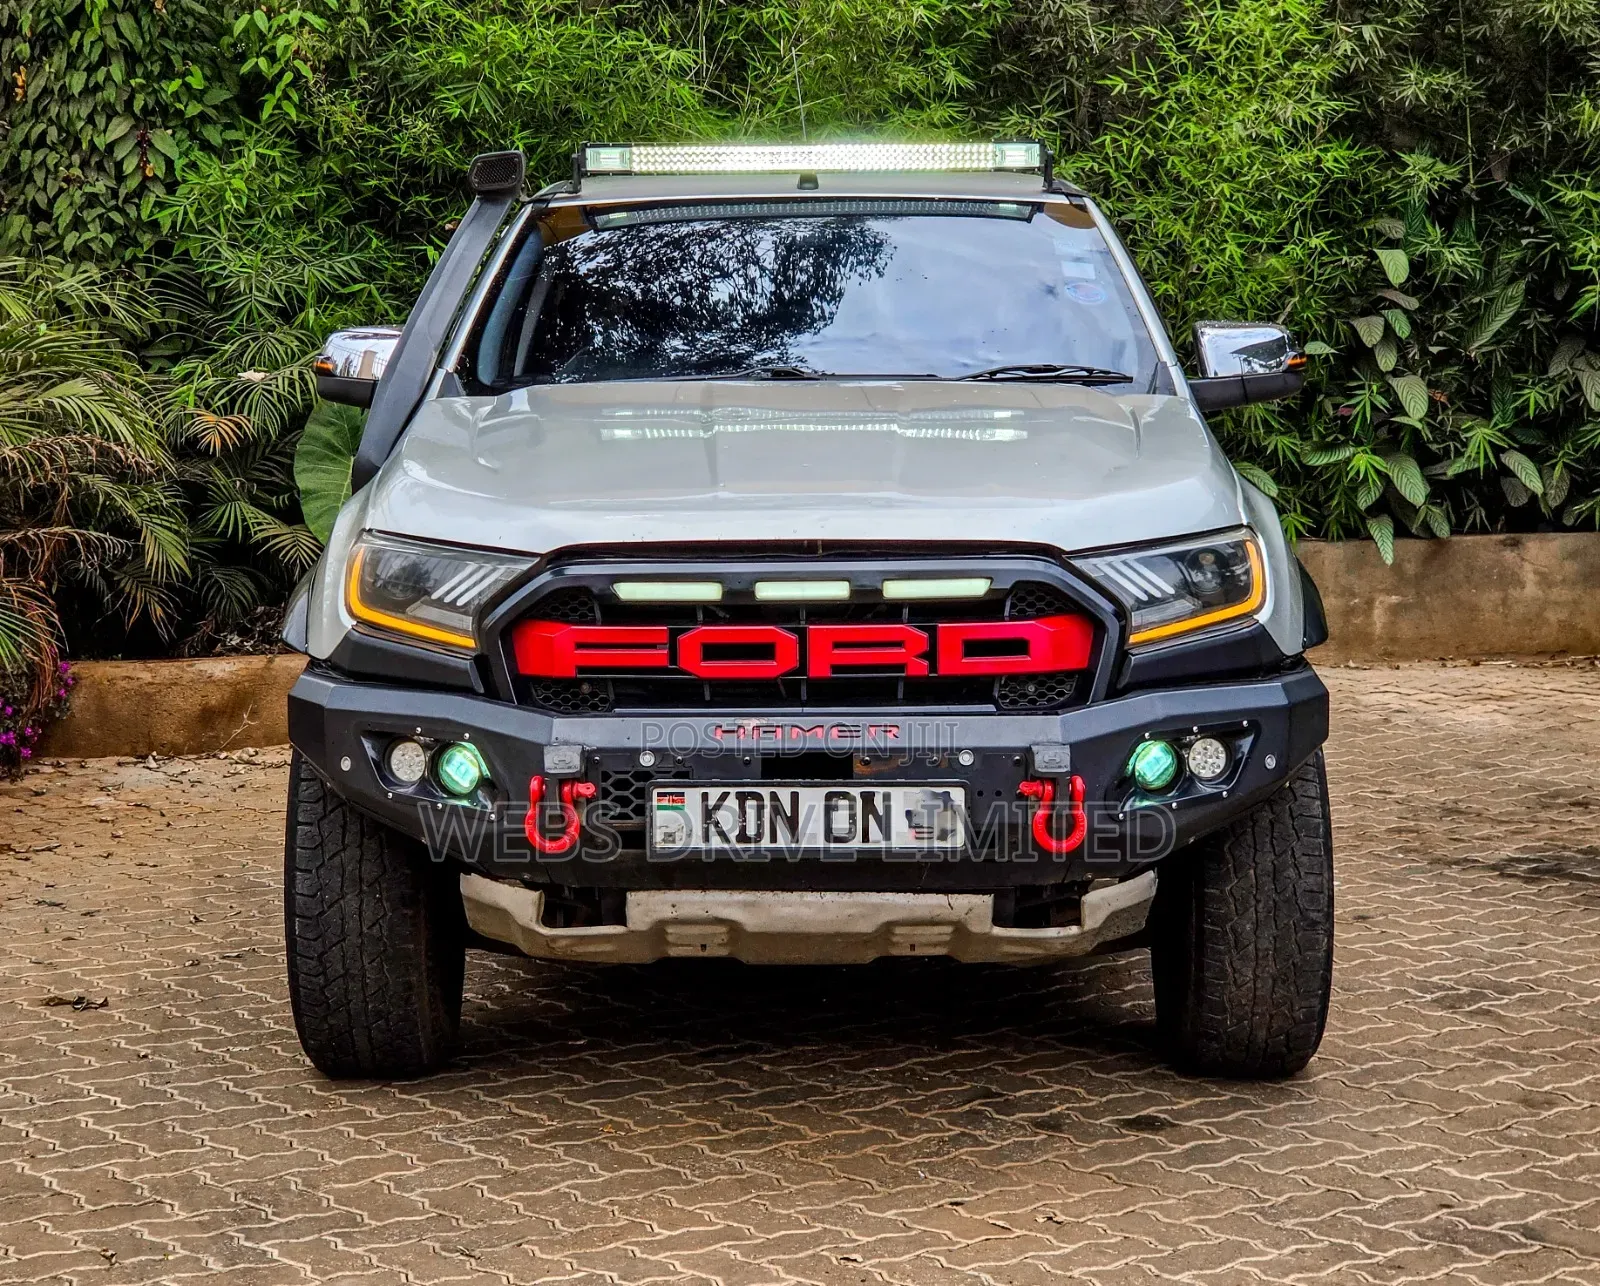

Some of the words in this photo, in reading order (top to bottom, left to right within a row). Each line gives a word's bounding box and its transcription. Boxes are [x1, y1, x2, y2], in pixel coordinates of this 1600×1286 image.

[512, 614, 1094, 680] FORD
[714, 724, 900, 739] HAMER
[701, 791, 799, 844] KDN
